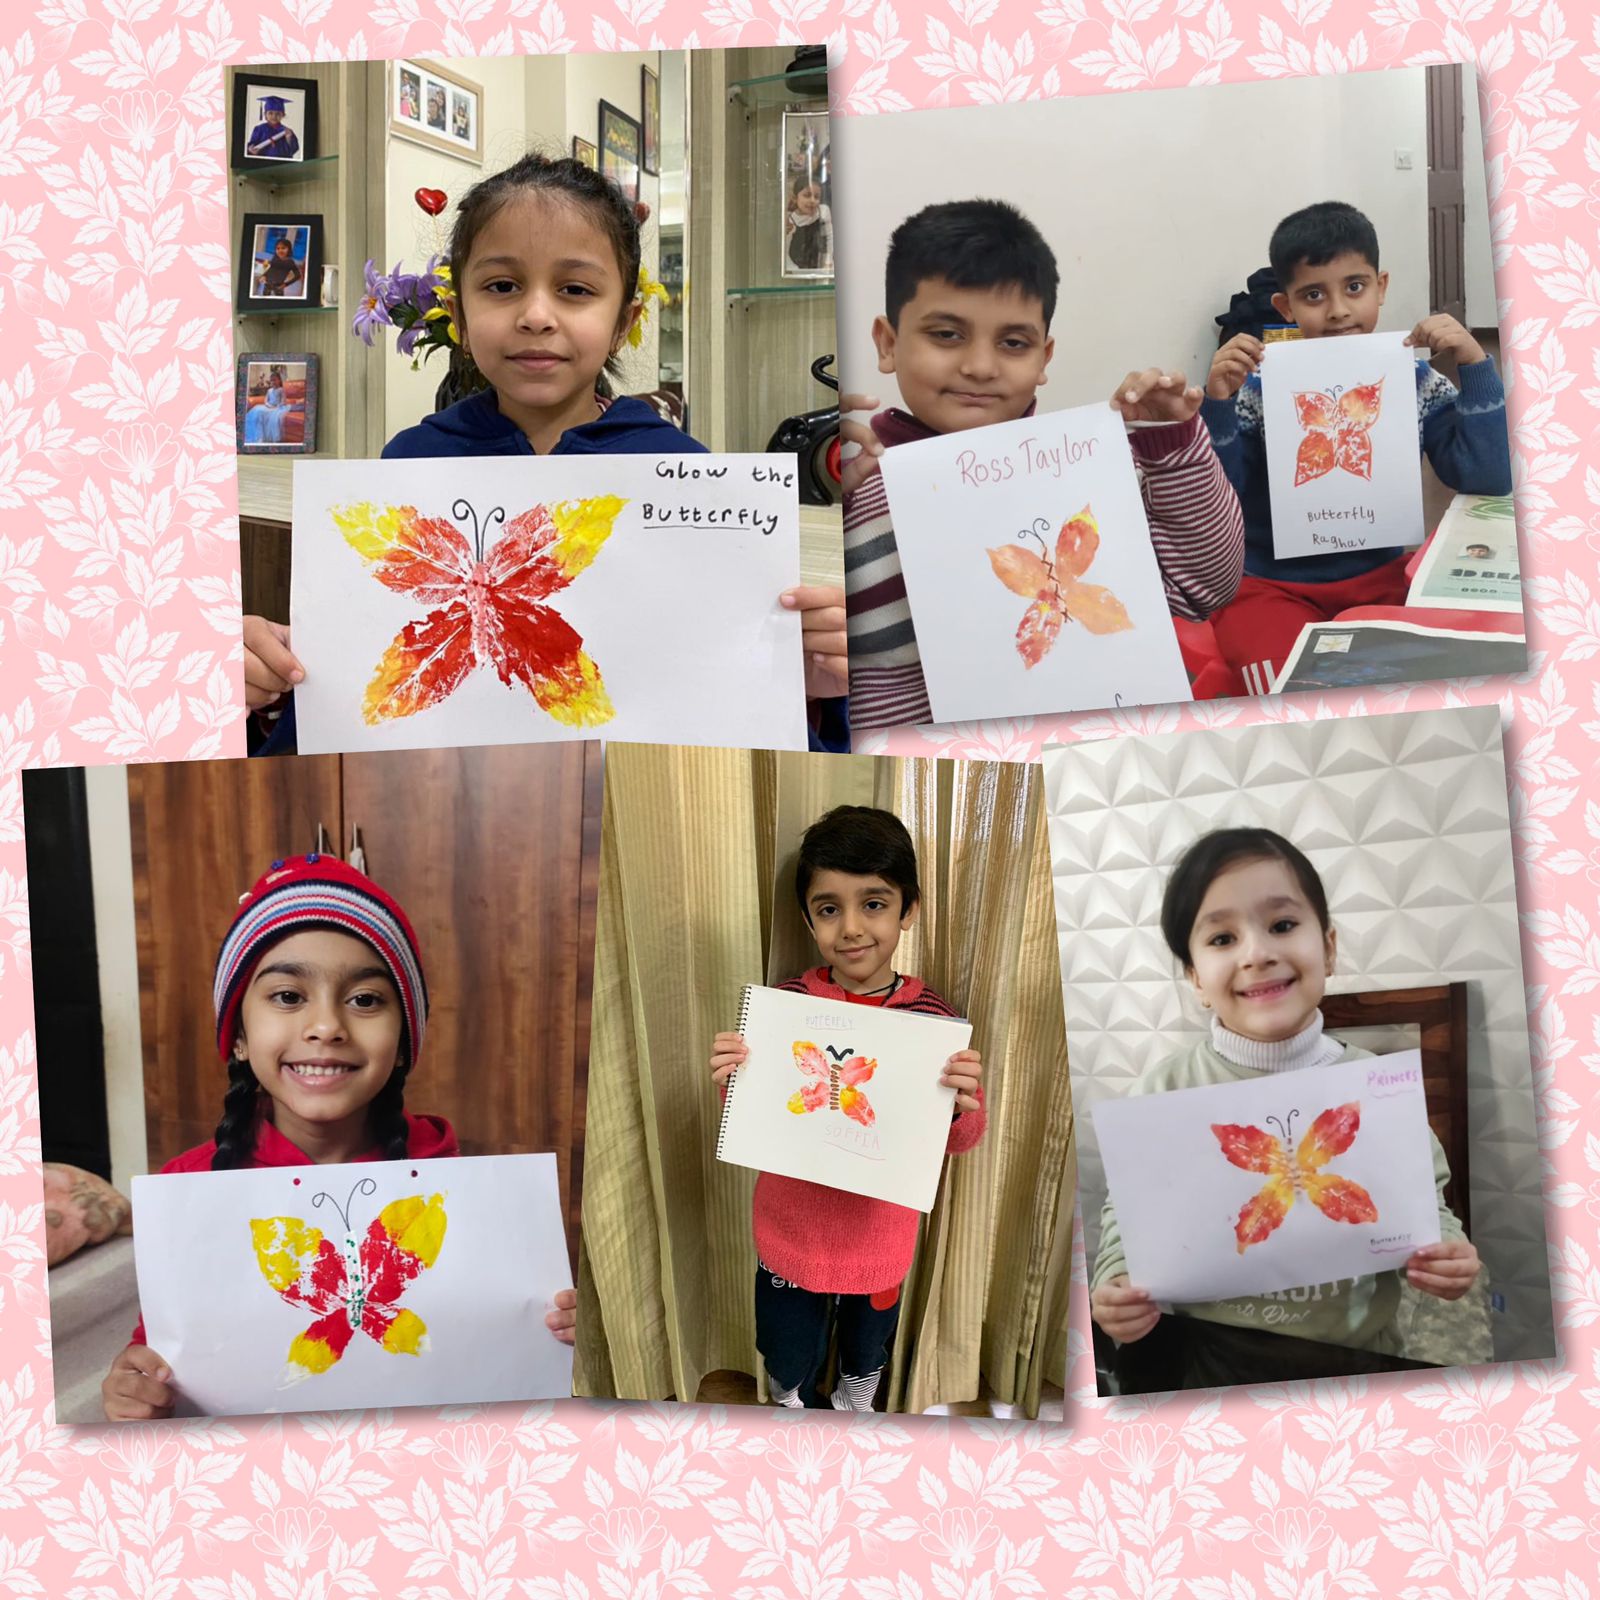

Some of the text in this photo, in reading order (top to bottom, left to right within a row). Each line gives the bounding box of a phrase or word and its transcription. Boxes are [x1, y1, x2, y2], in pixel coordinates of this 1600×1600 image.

[955, 433, 1100, 487] Ross Taylor
[751, 466, 794, 488] the
[642, 502, 778, 535] Butterfly
[1312, 533, 1367, 549] Raghav
